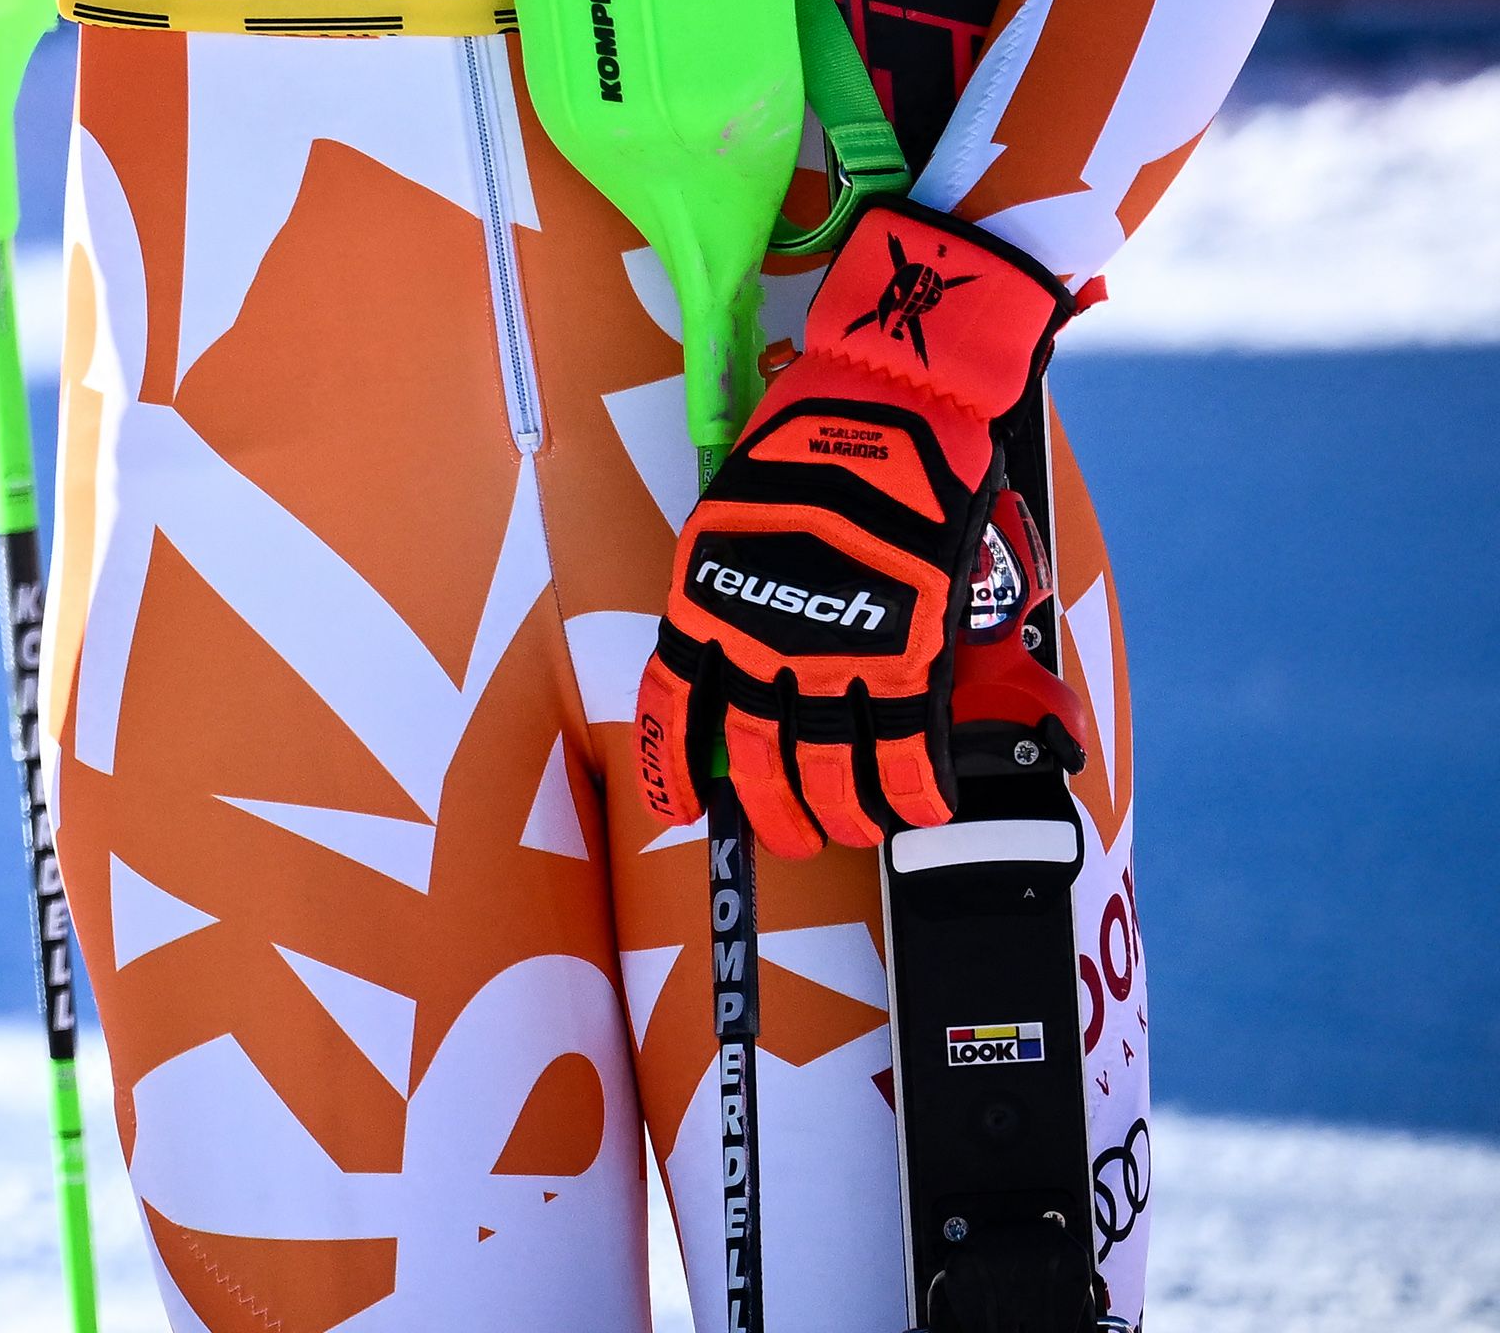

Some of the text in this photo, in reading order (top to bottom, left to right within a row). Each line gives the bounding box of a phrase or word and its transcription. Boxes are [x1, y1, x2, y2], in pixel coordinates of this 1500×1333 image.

[808, 438, 889, 460] WARRIORS
[696, 559, 887, 631] reusch
[949, 1041, 1016, 1063] LOOK
